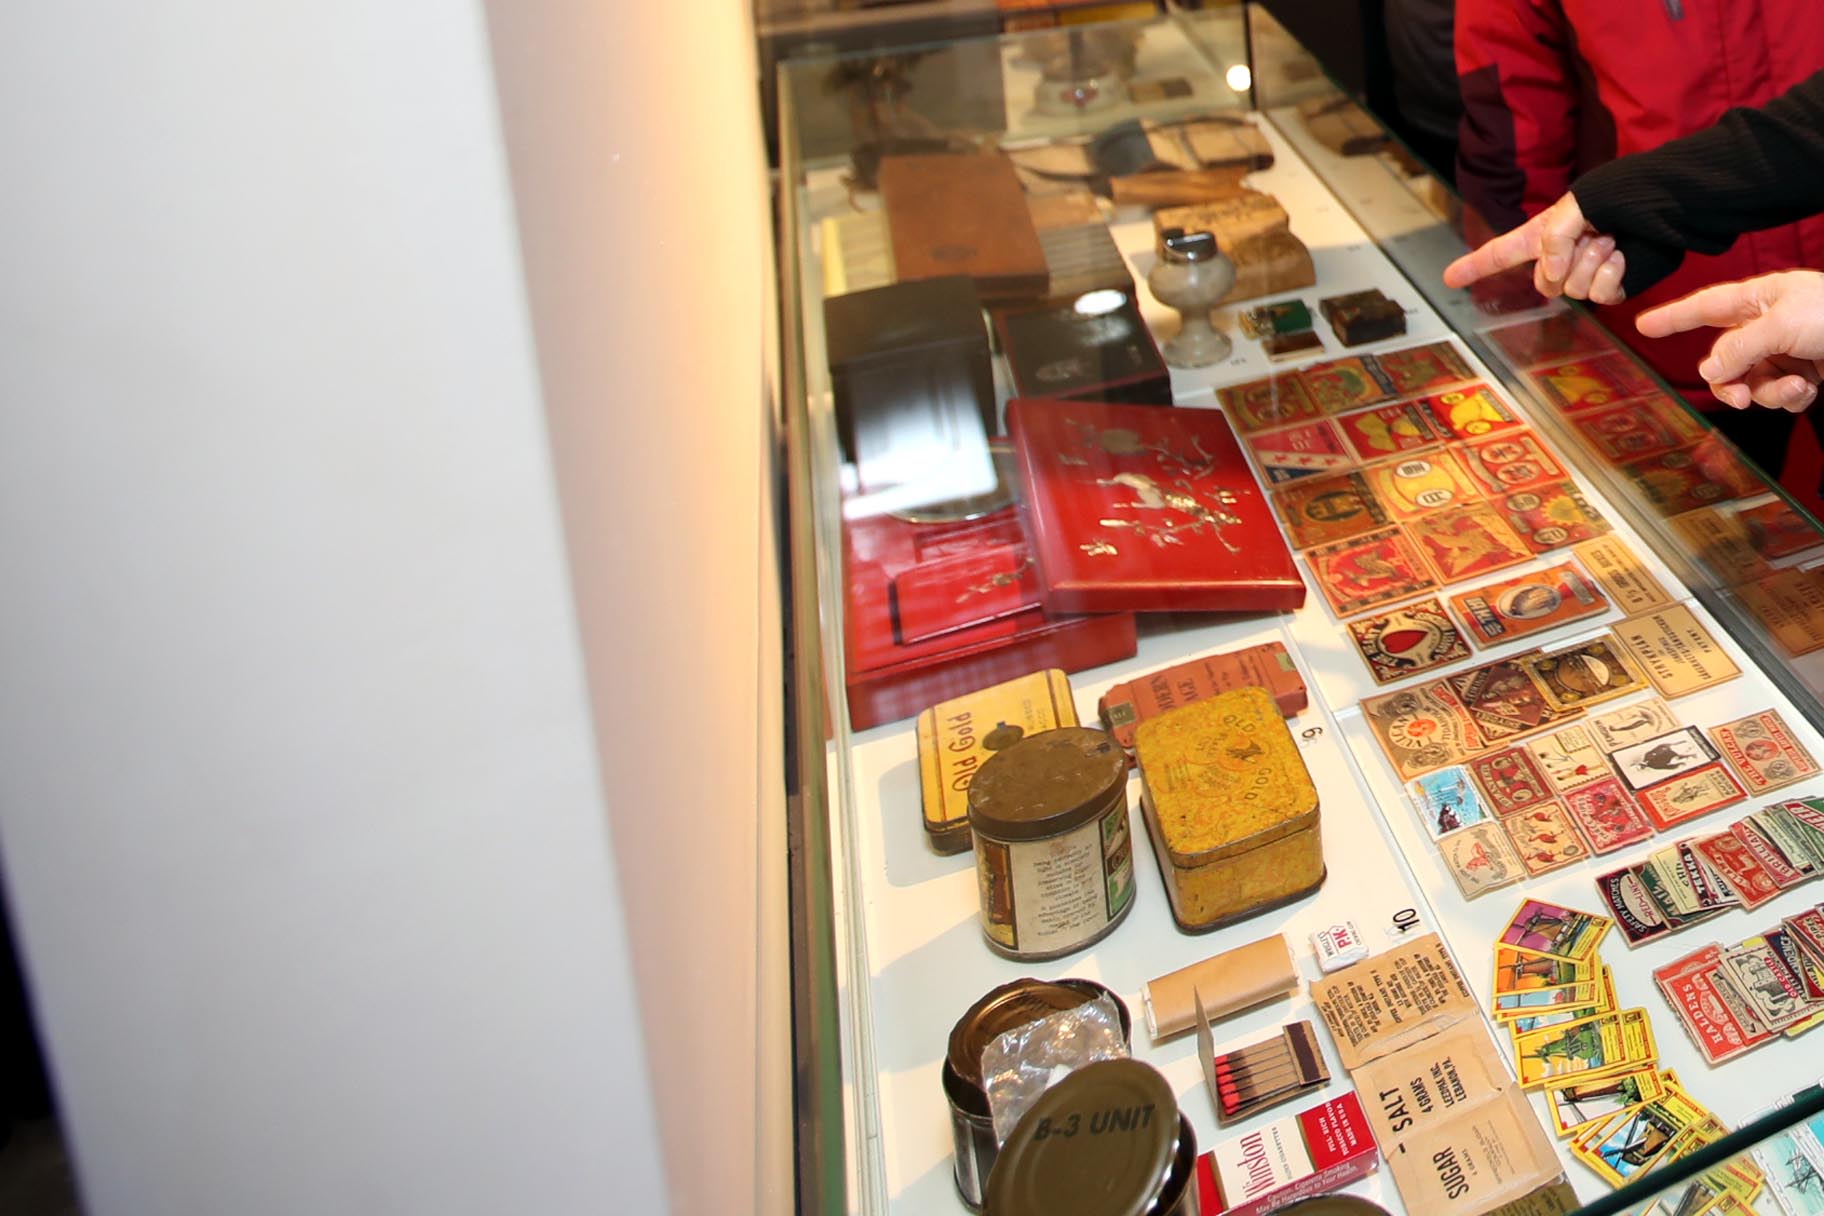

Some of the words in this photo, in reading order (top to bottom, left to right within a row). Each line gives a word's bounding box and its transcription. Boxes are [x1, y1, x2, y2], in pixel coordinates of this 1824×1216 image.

[946, 711, 976, 753] Gold
[1223, 714, 1257, 734] OLD
[953, 755, 978, 792] Old
[1244, 767, 1273, 801] GOLD
[1681, 852, 1706, 894] TEKKA
[1610, 877, 1625, 910] MATCHES
[1392, 908, 1421, 933] 10
[1619, 906, 1648, 932] SAFETY
[1764, 957, 1786, 983] CASTLE
[1782, 982, 1798, 998] OLD
[1681, 982, 1723, 1044] HALDENS
[1407, 1075, 1433, 1108] GRAMS
[1033, 1113, 1082, 1142] B-3
[1089, 1103, 1157, 1136] UNIT
[1322, 1101, 1340, 1128] FLAVOR
[1375, 1084, 1415, 1133] SALT
[1419, 1103, 1435, 1115] 4
[1332, 1126, 1351, 1156] TOBACCO
[1344, 1125, 1358, 1146] MADE
[1237, 1130, 1277, 1199] Winston
[1432, 1146, 1470, 1200] SUGAR
